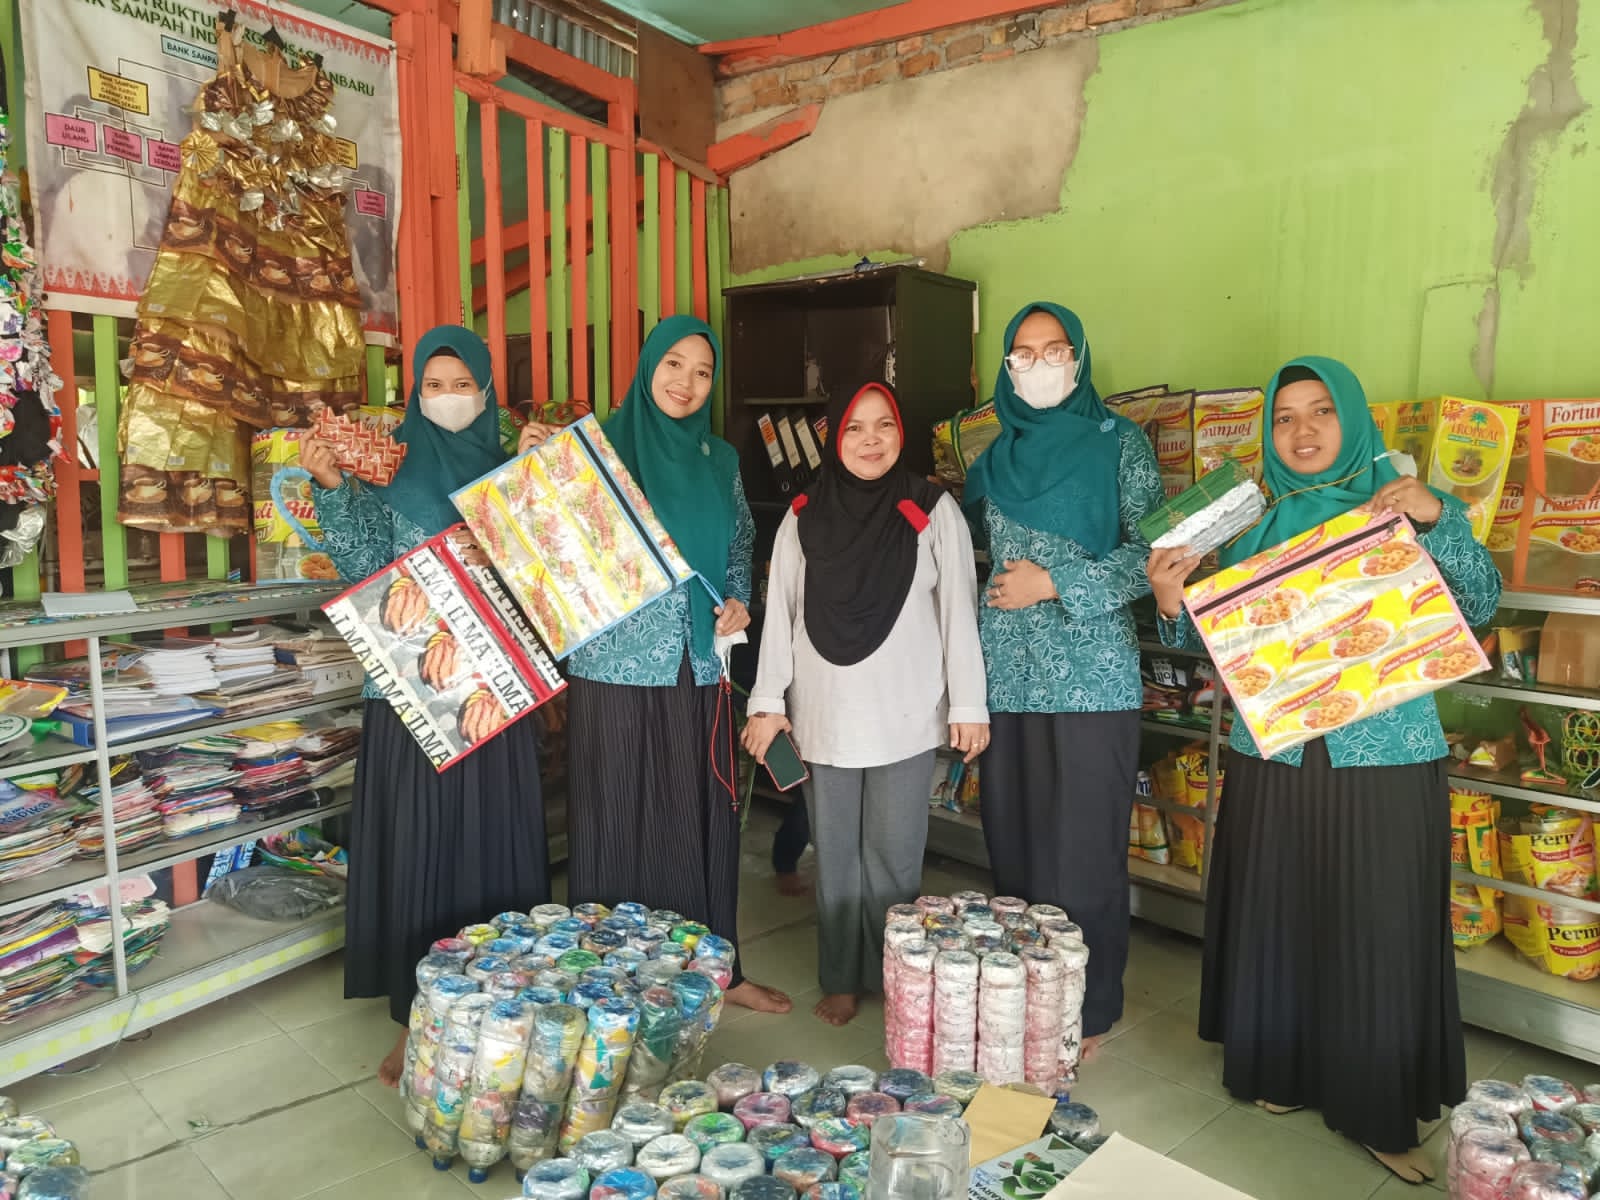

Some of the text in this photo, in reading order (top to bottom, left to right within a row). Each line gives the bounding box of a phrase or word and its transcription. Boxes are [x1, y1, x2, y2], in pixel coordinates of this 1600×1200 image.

[111, 0, 184, 33] SAMPAH
[191, 24, 217, 44] IND
[167, 41, 217, 64] BANK SAMPA
[61, 132, 90, 144] ULANG
[1201, 421, 1252, 438] Fortune
